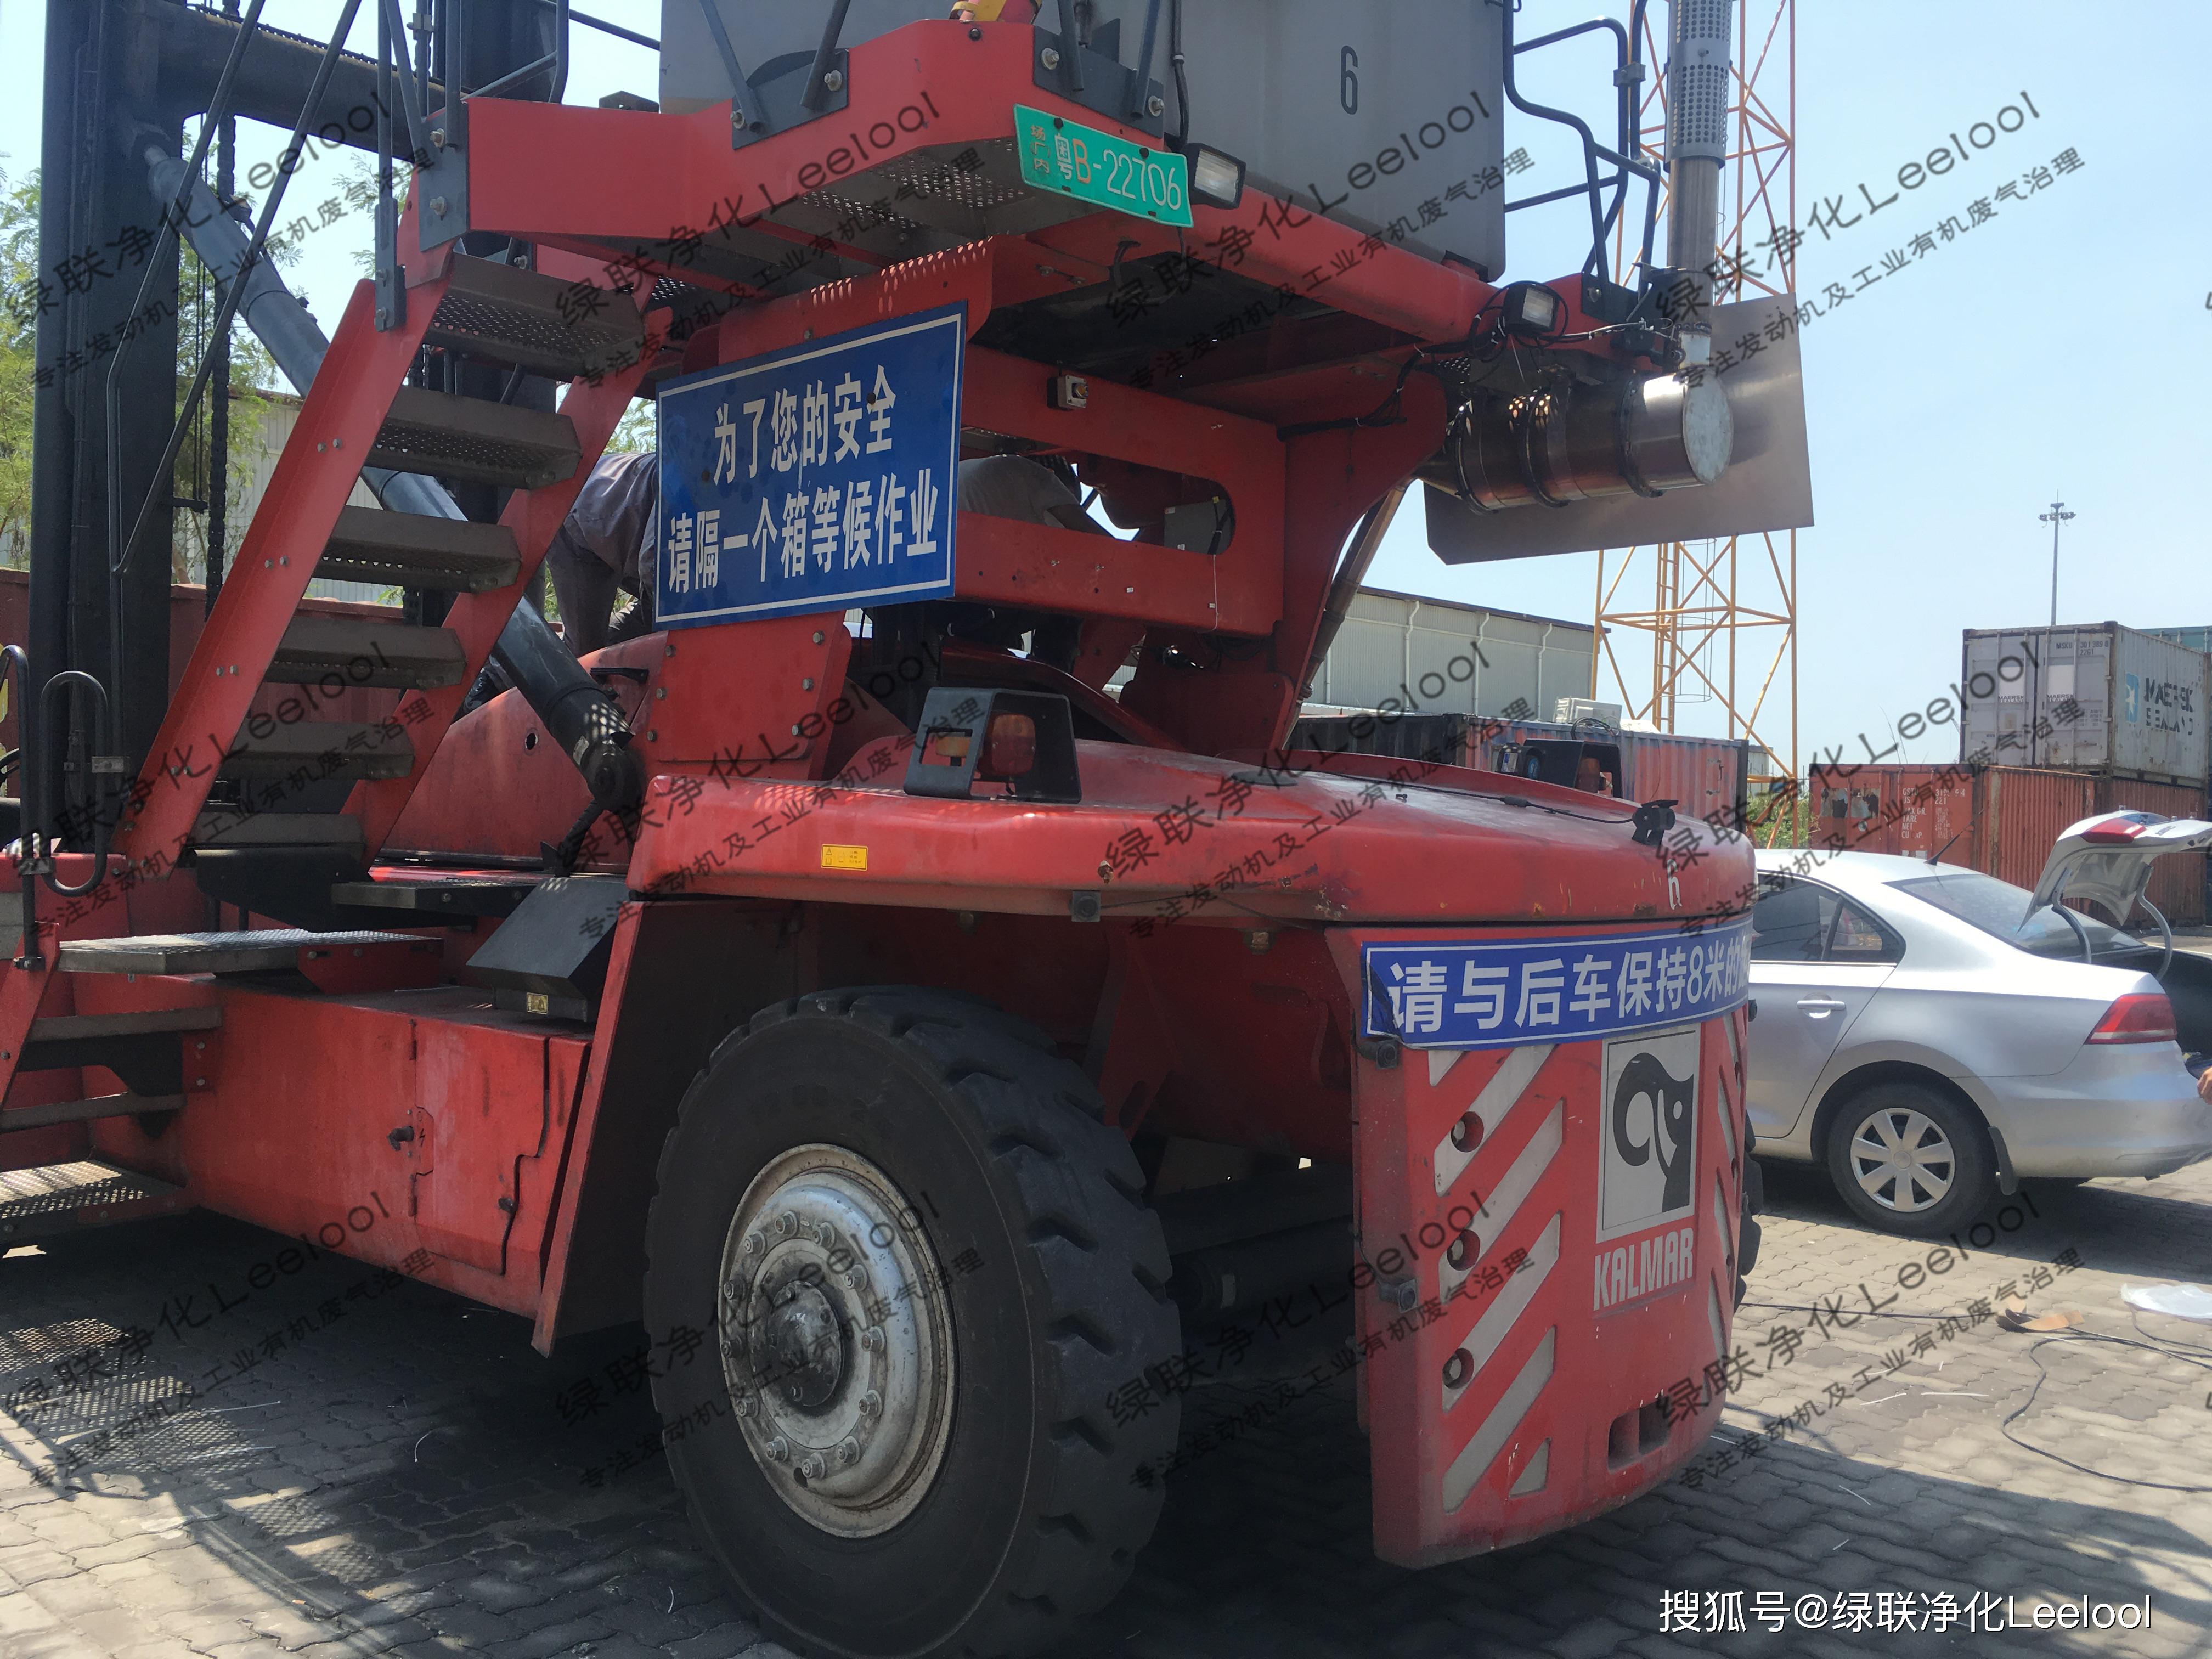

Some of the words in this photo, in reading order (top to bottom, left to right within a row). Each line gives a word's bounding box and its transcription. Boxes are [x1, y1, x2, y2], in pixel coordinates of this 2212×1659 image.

[1341, 45, 1358, 115] 6
[713, 364, 896, 486] 为了您的安全
[668, 467, 939, 594] 请隔一个箱等候作业
[1901, 822, 1913, 831] NET
[1903, 815, 1918, 823] TARE
[1593, 1227, 1694, 1312] KALMAR
